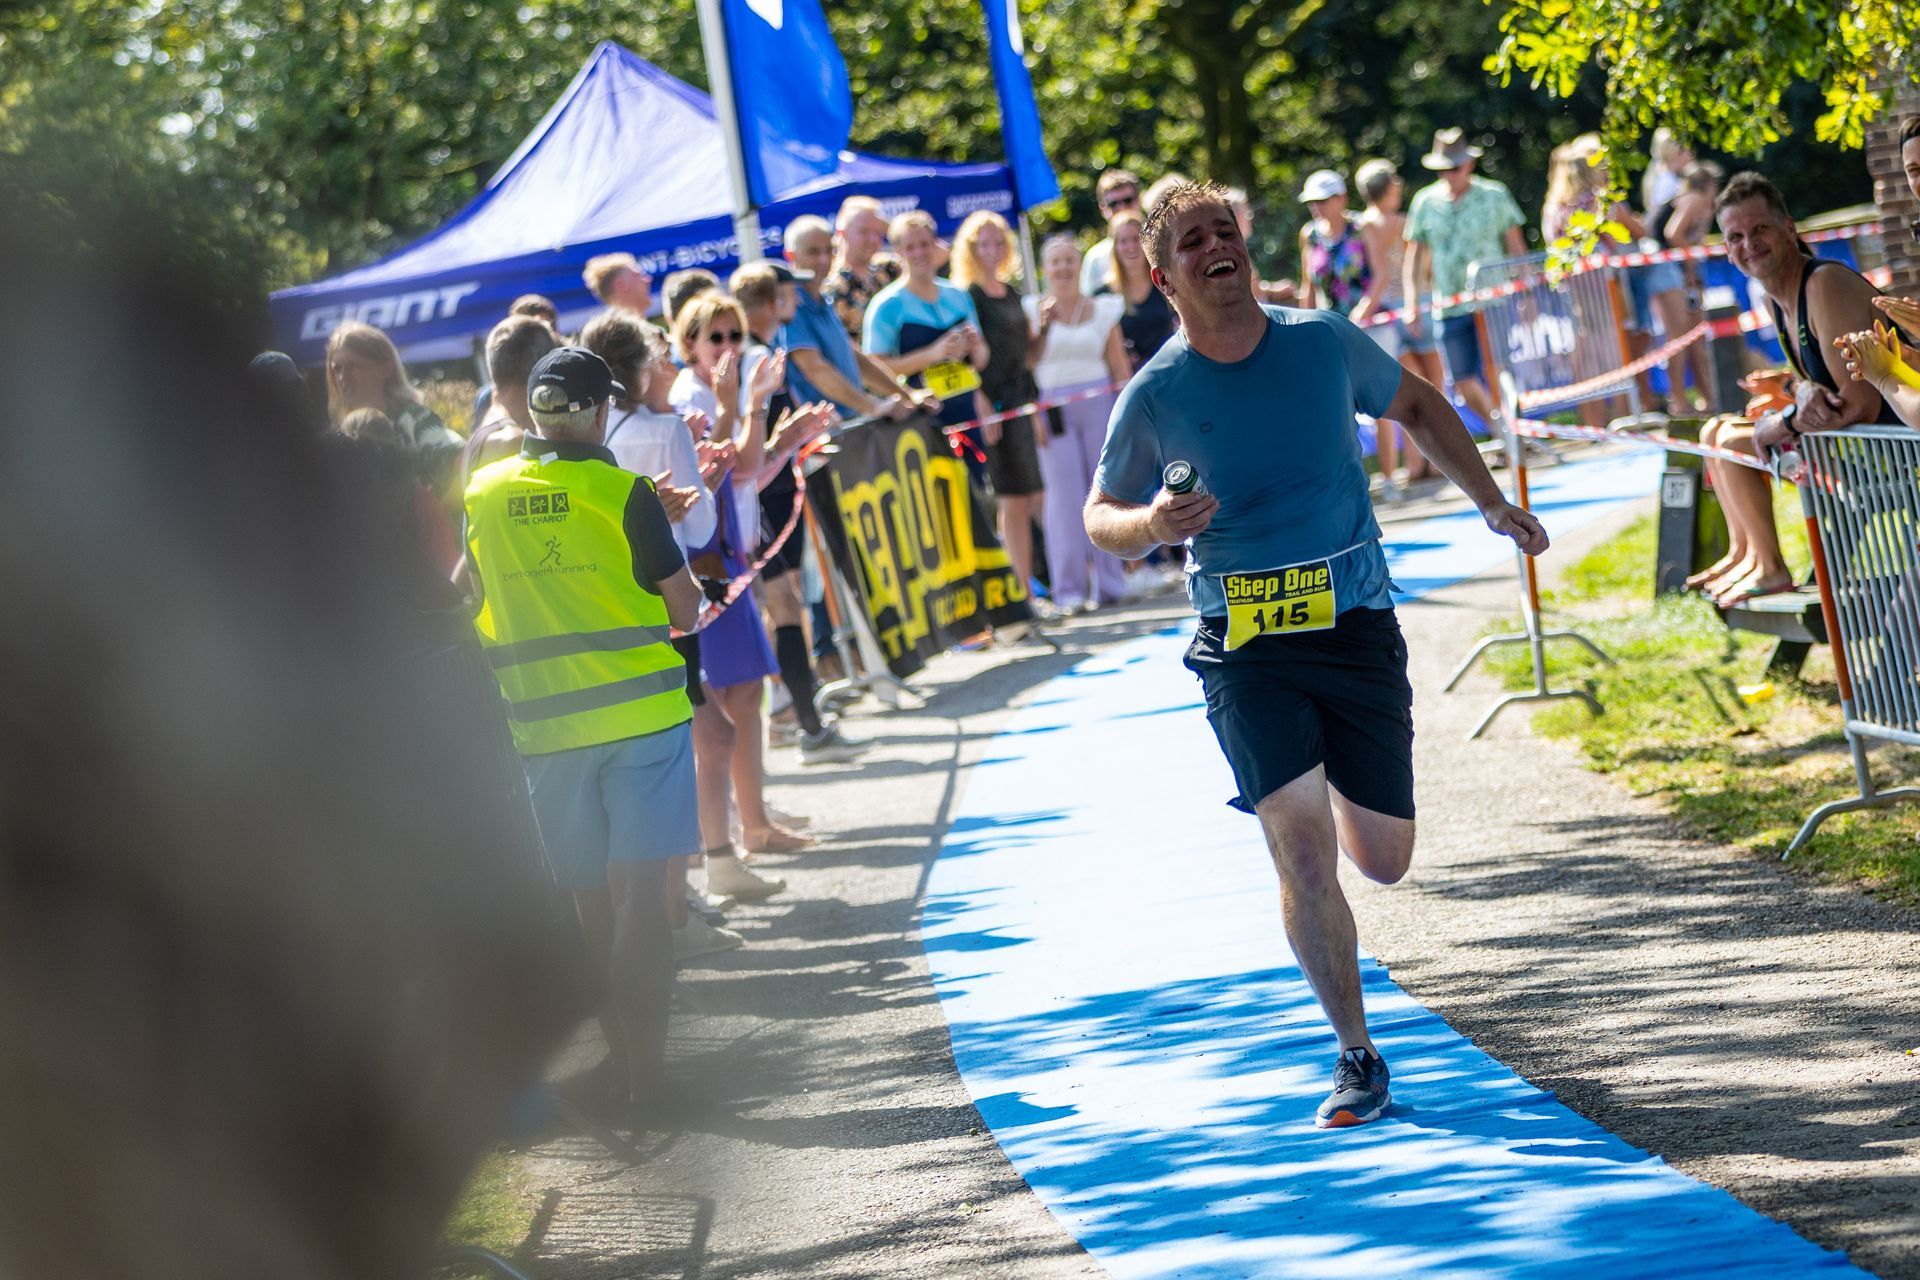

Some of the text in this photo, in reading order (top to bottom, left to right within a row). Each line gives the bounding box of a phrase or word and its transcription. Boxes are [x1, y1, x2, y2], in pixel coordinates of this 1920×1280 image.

[302, 281, 481, 340] GIANT
[514, 514, 568, 526] THE CHARIOT
[1227, 568, 1328, 601] Step One
[1228, 597, 1254, 605] TRIATHLON
[1253, 601, 1310, 633] 115
